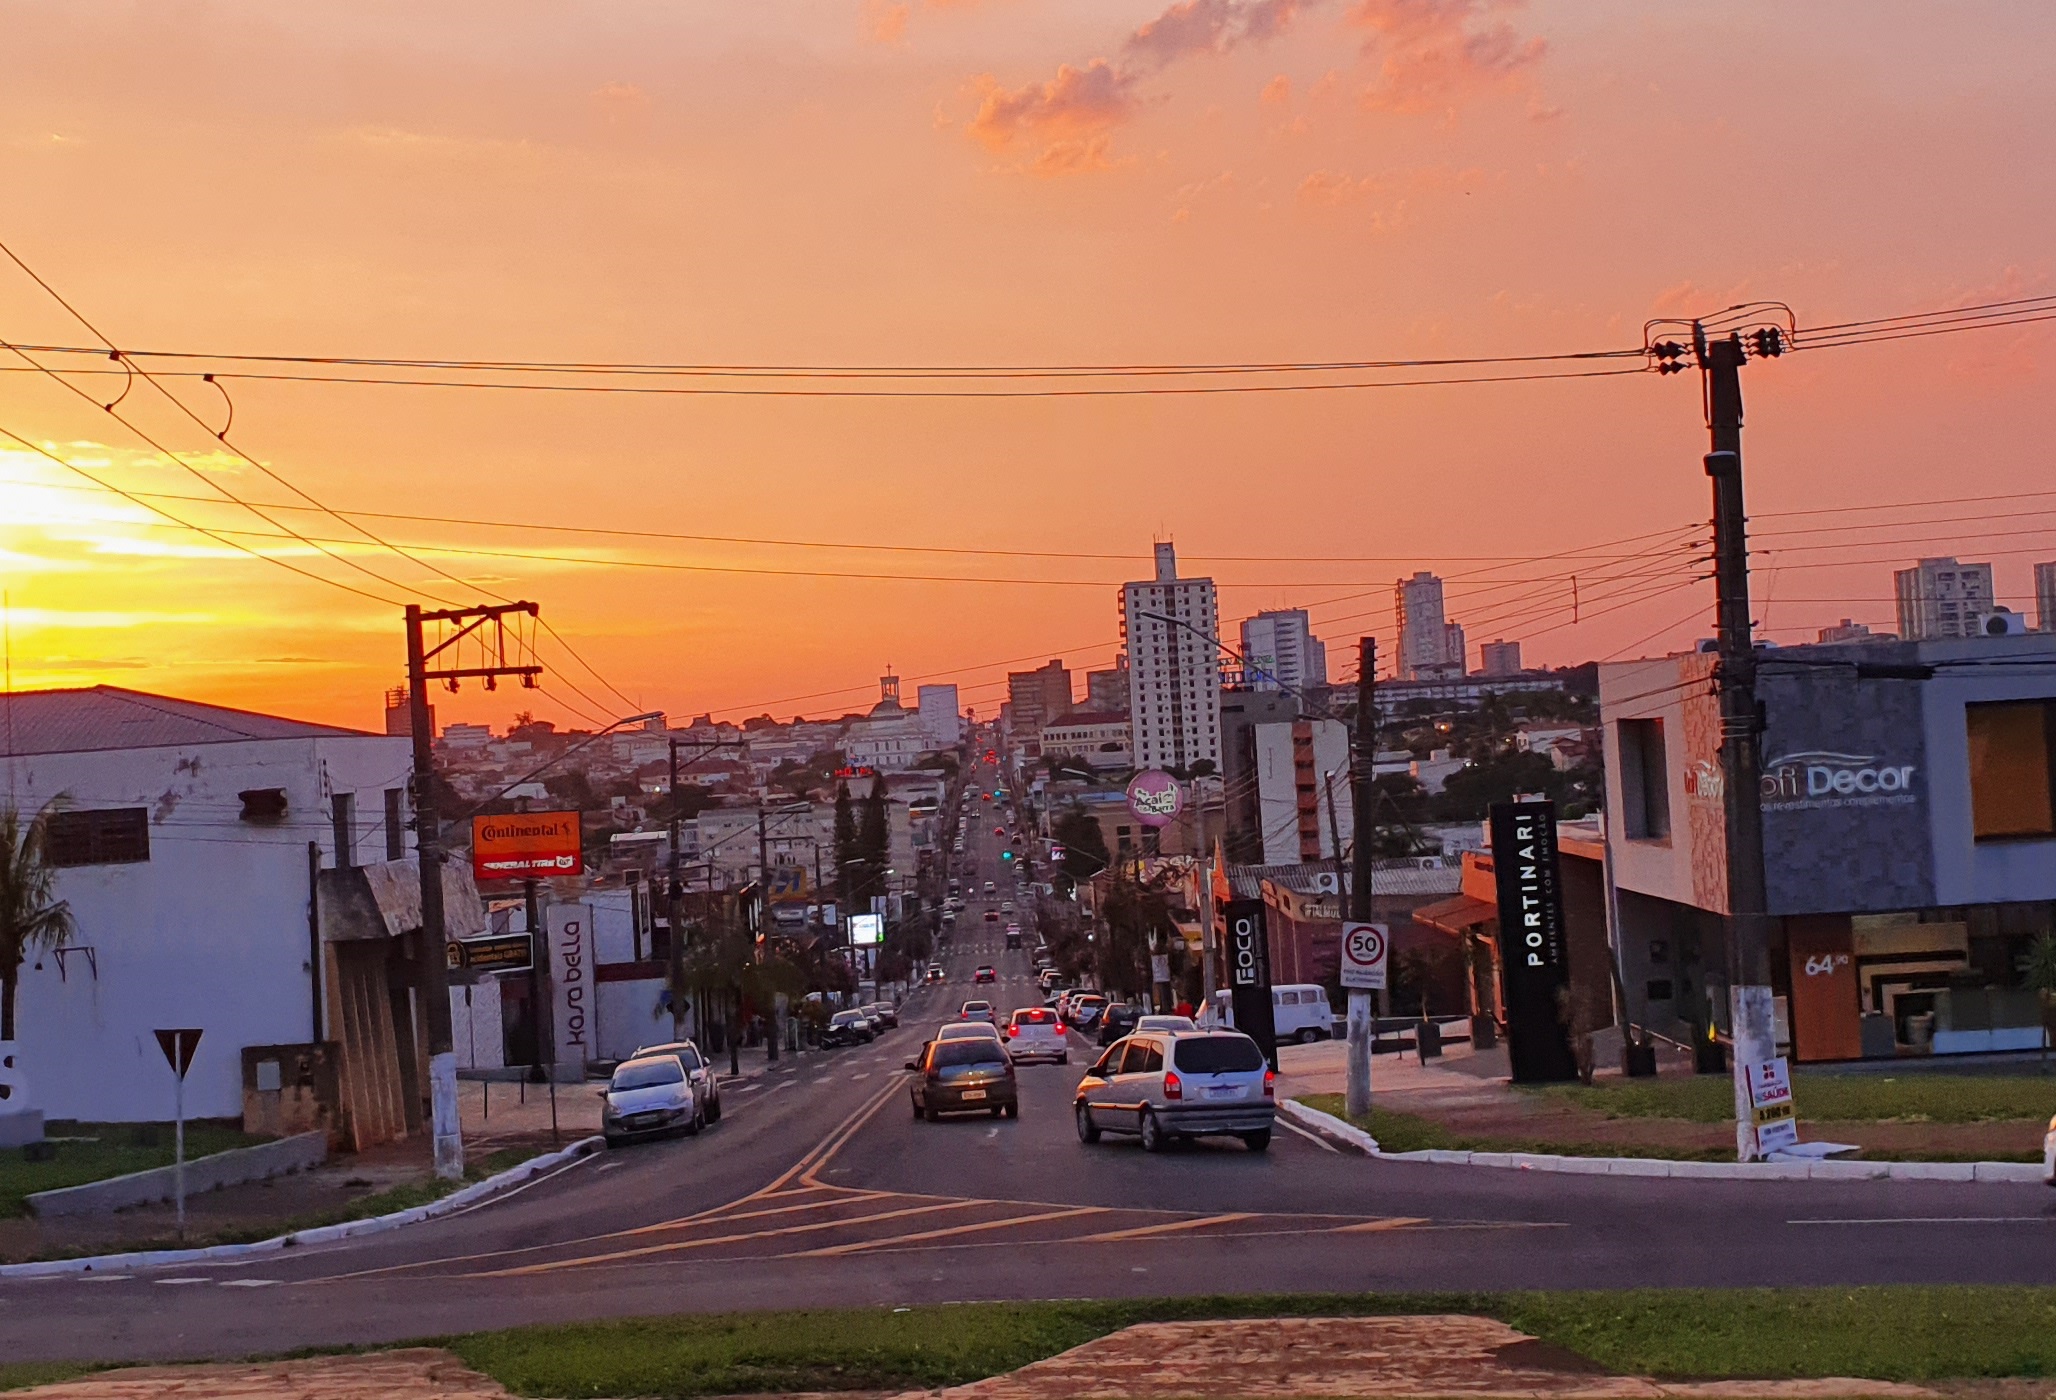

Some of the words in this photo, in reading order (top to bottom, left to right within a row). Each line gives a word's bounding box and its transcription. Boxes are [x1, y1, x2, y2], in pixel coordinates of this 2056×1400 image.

[1760, 768, 1799, 797] ofi
[1807, 766, 1916, 796] Decor
[481, 823, 558, 842] Continental
[1515, 814, 1545, 967] PORTINARI
[1543, 870, 1553, 894] COM
[1235, 918, 1255, 985] FOCO
[1352, 935, 1377, 953] 50
